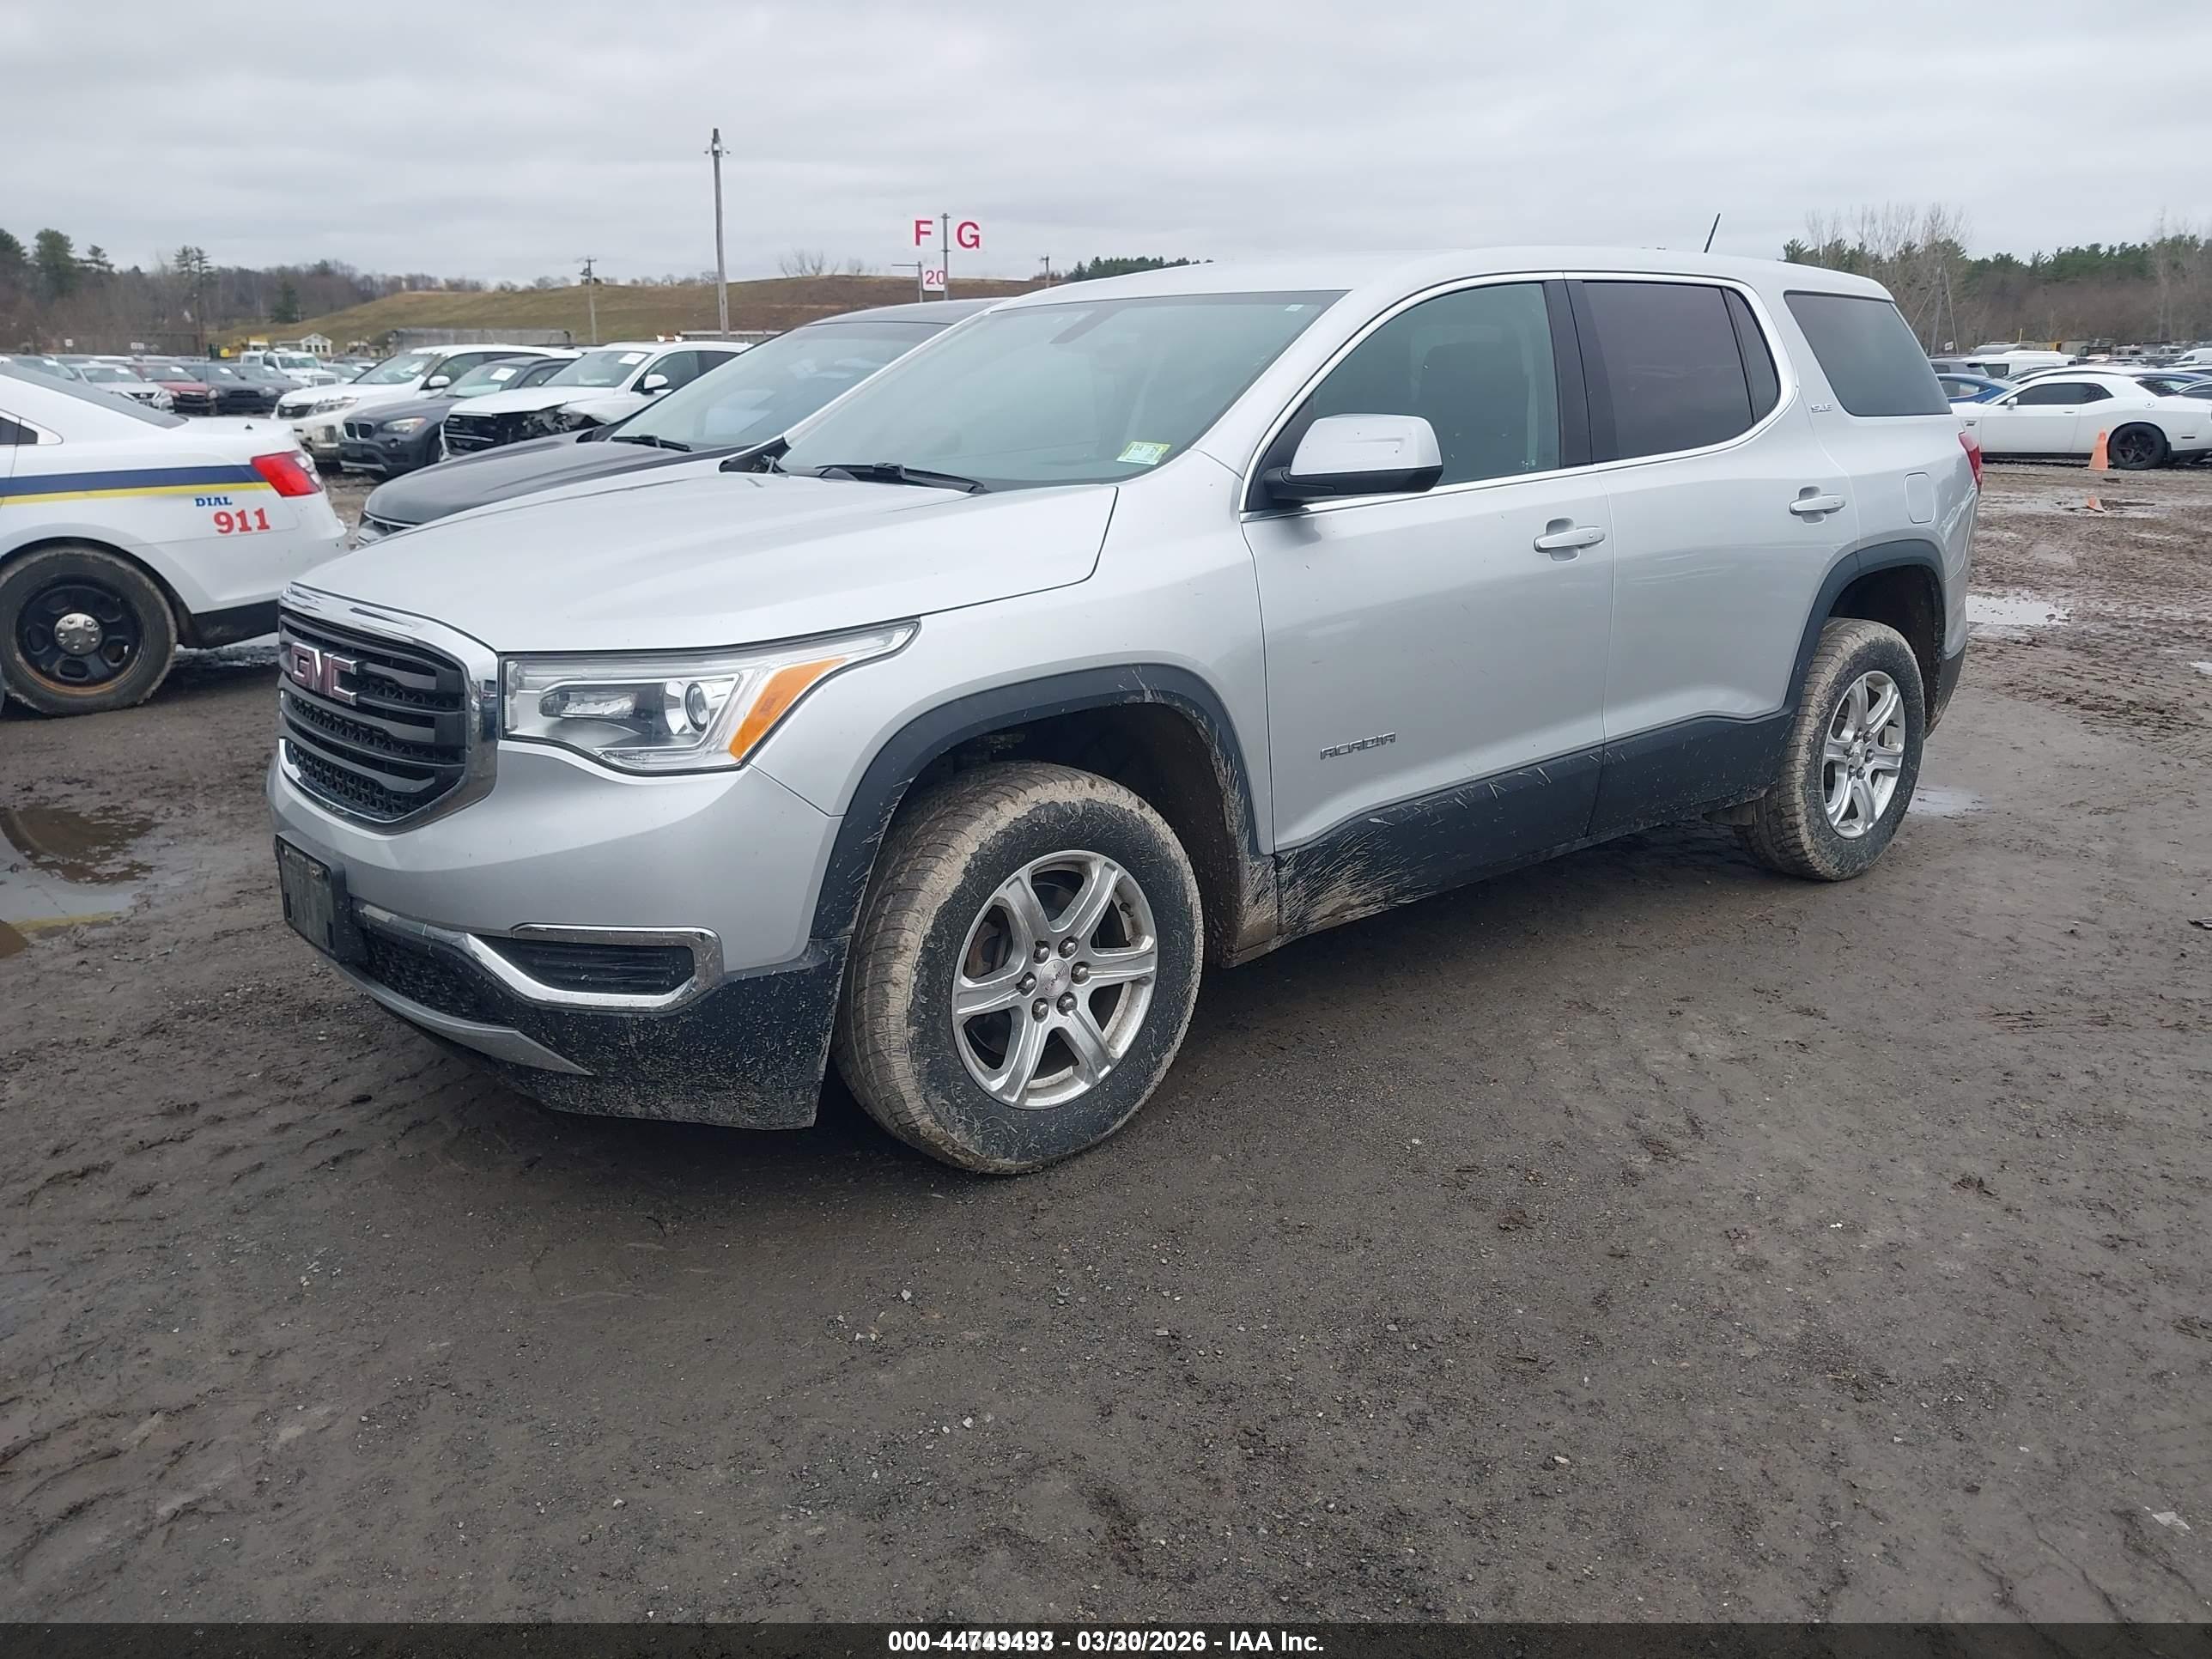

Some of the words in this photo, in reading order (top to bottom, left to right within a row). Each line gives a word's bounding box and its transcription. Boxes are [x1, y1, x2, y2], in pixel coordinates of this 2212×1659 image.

[915, 220, 933, 246] F
[957, 221, 980, 249] G
[925, 270, 945, 285] 20
[195, 496, 233, 507] DIAL
[214, 507, 270, 534] 911
[292, 641, 357, 706] GMC
[1320, 732, 1396, 760] ACADIA
